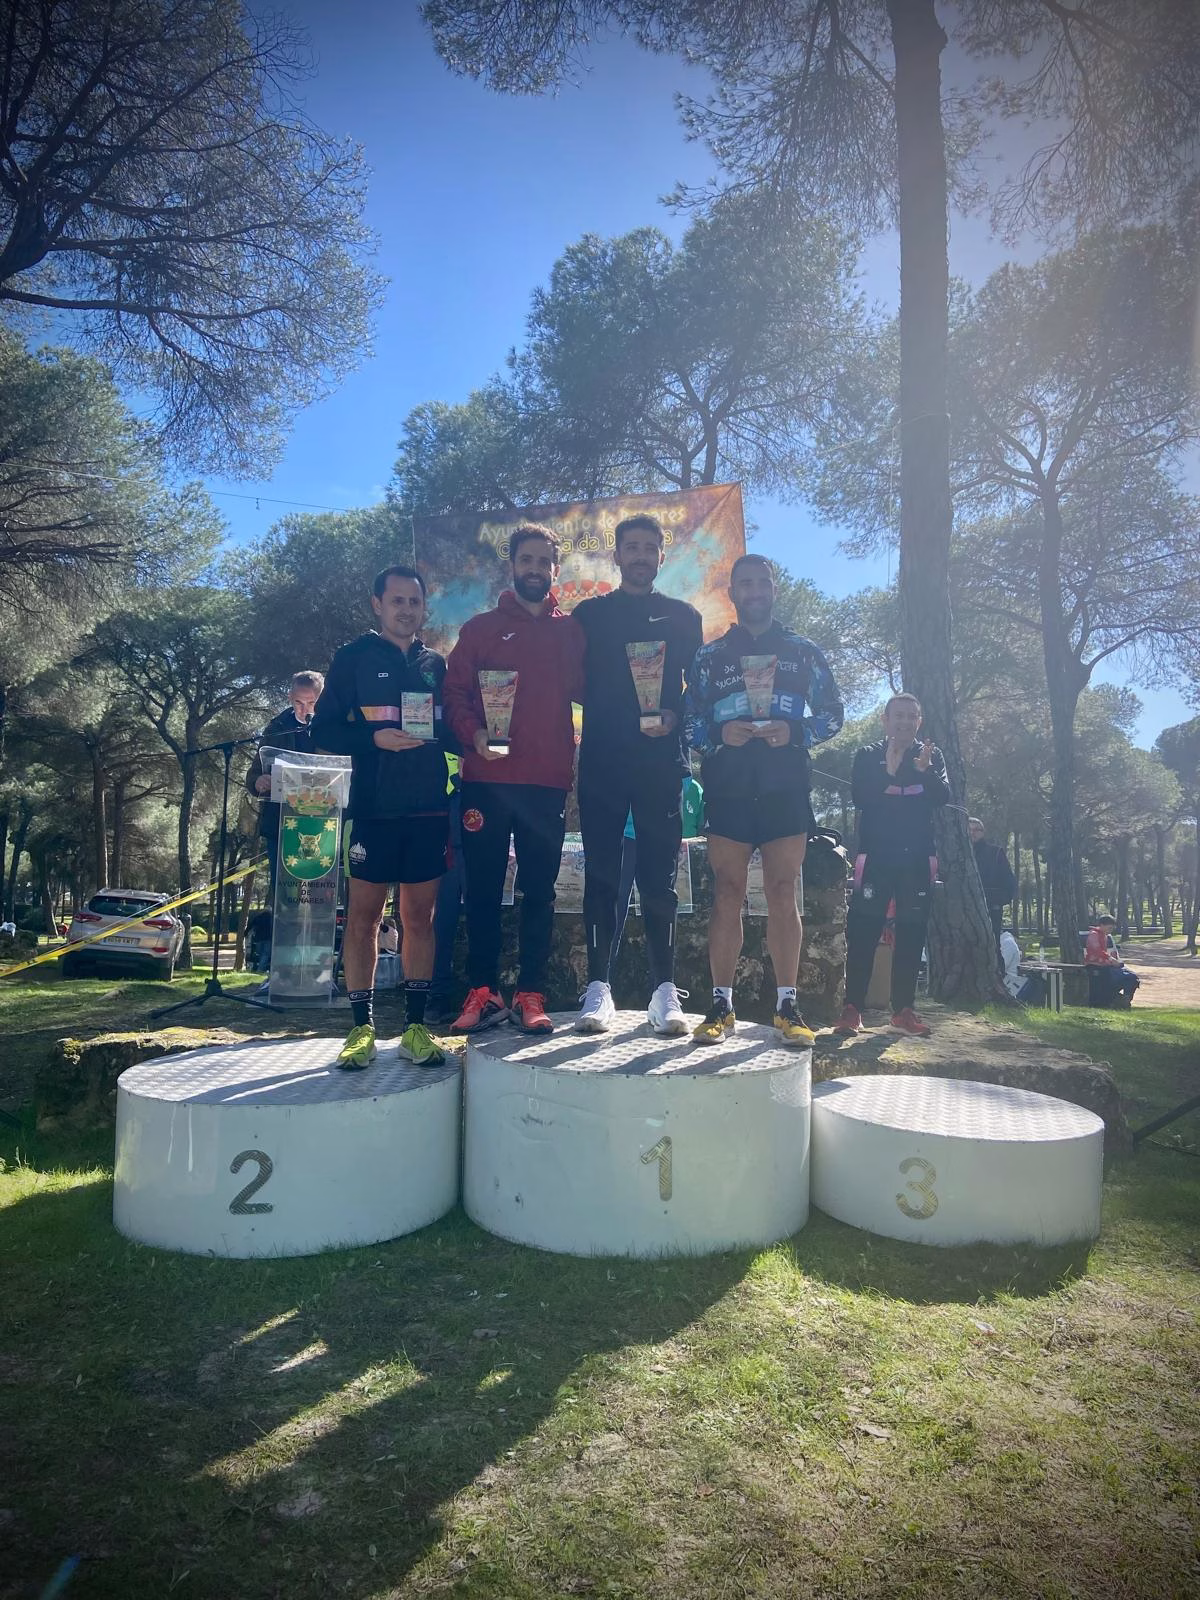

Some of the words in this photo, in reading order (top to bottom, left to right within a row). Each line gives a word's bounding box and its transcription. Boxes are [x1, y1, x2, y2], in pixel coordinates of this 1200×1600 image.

[578, 532, 599, 550] de
[598, 510, 615, 528] de
[229, 1150, 275, 1215] 2
[640, 1136, 673, 1201] 1
[896, 1157, 939, 1219] 3
